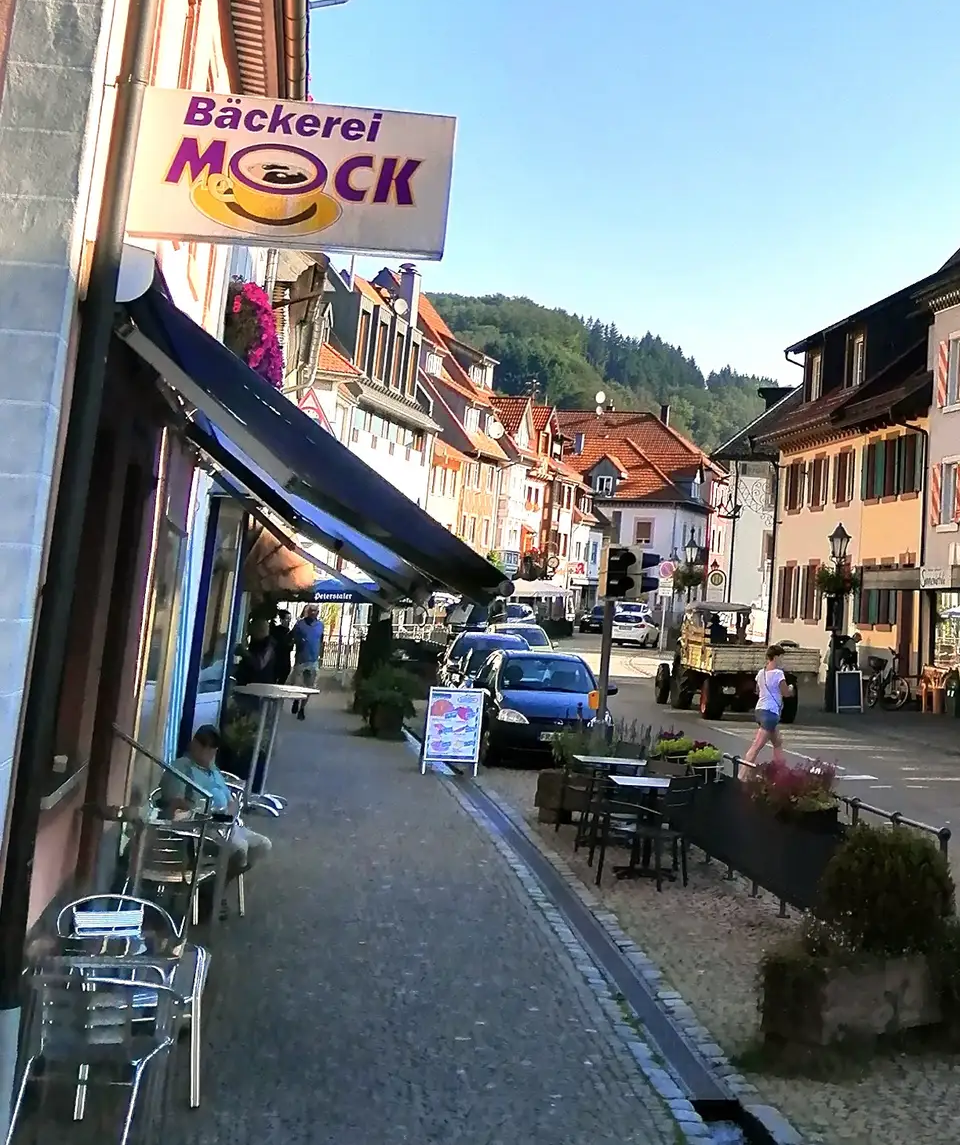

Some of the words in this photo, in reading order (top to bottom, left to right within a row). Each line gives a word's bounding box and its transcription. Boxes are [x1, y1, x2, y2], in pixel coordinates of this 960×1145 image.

[183, 96, 383, 143] Bäckerei
[162, 135, 422, 207] MOCK
[314, 592, 353, 601] Peterstaler
